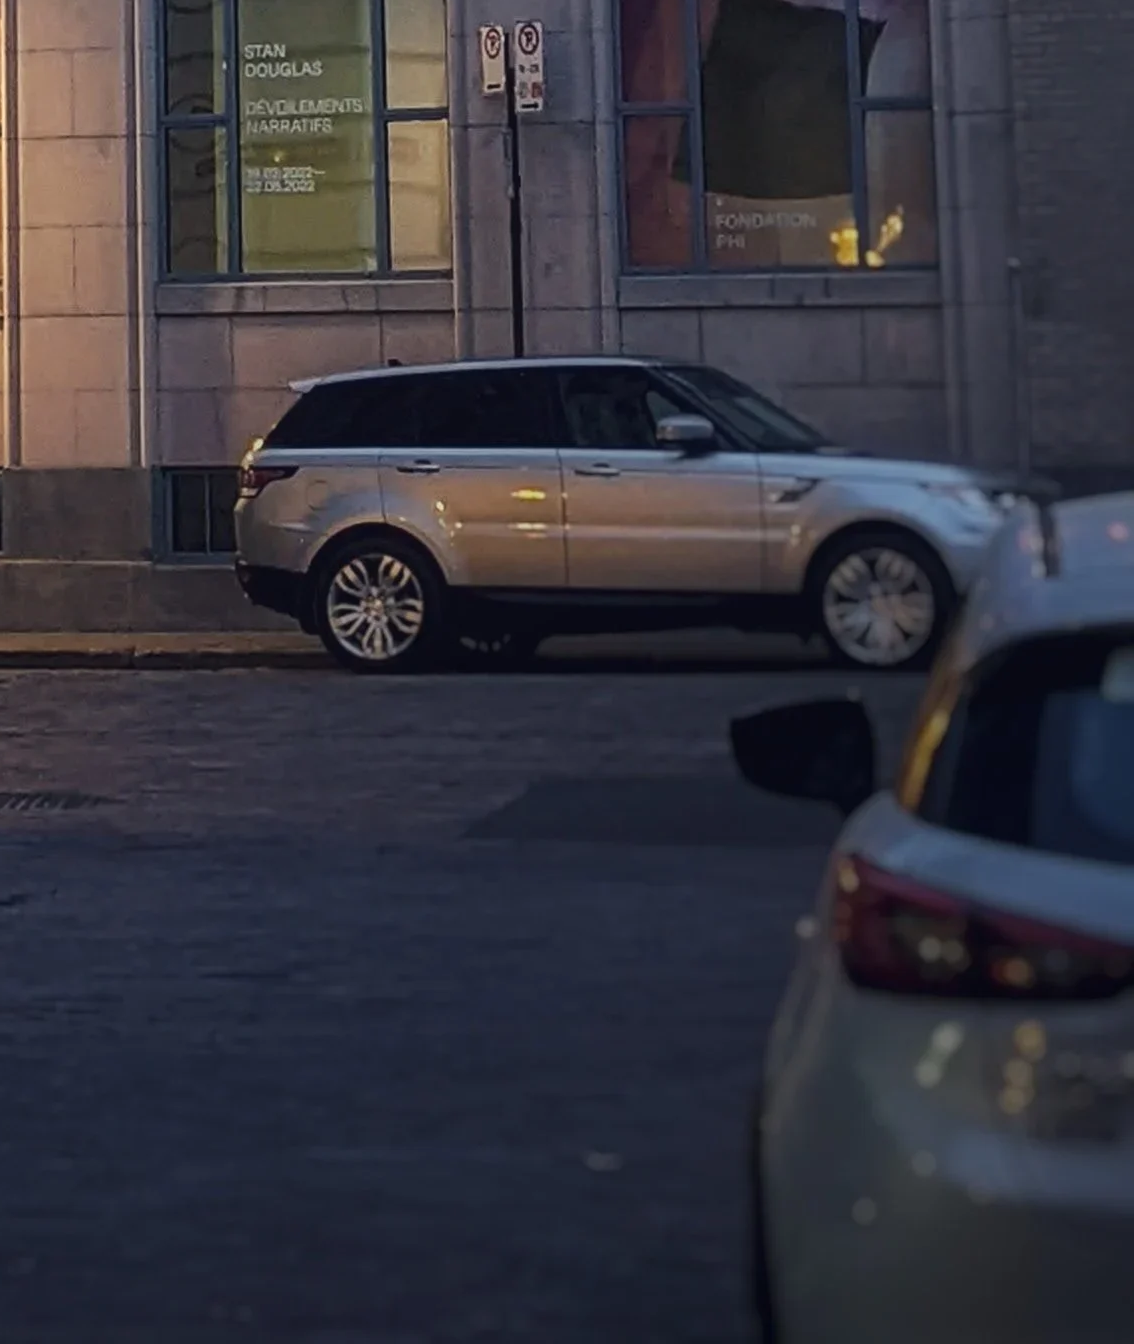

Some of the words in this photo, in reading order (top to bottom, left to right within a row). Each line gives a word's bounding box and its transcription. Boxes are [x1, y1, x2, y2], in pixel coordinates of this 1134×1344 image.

[244, 44, 286, 59] STAN
[245, 61, 323, 78] DOUGLAS
[246, 118, 333, 134] NARRATIFS
